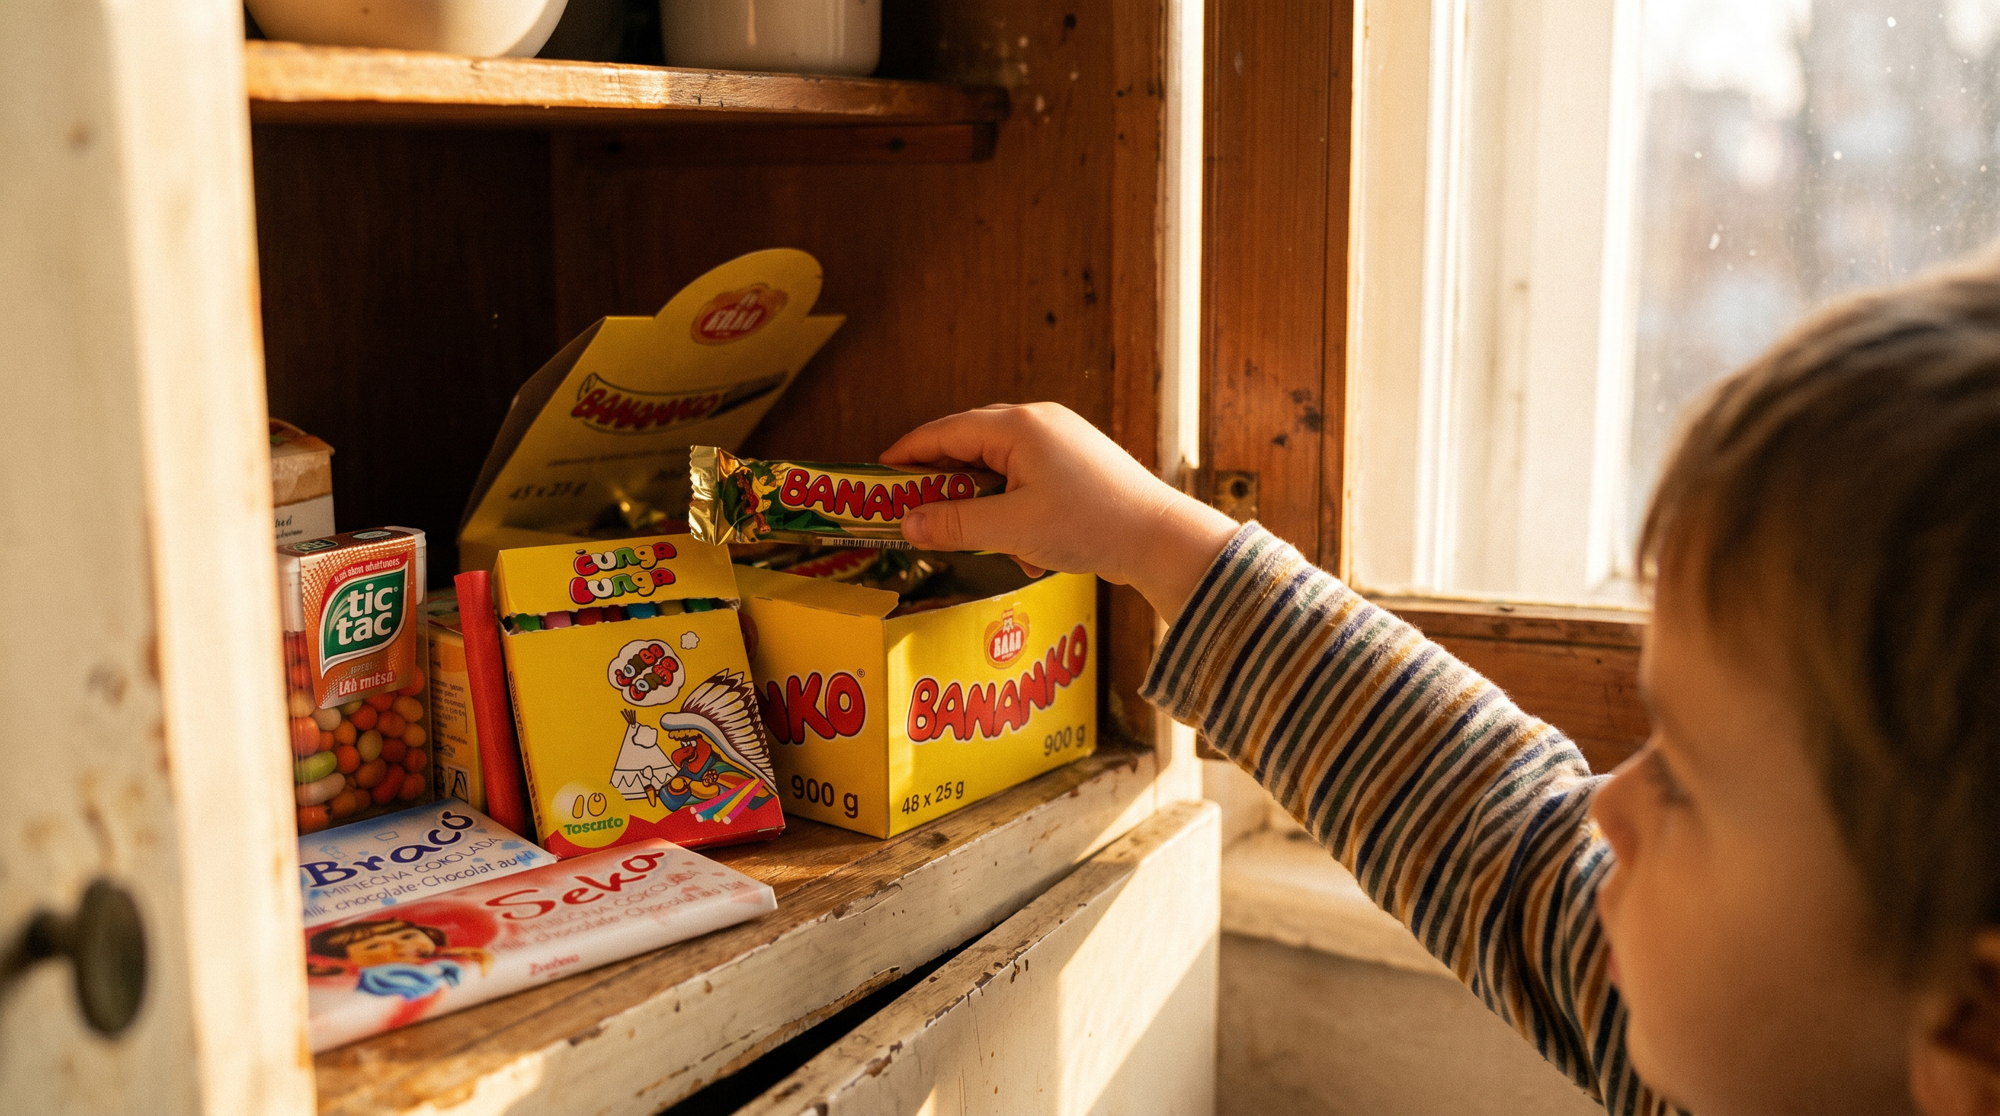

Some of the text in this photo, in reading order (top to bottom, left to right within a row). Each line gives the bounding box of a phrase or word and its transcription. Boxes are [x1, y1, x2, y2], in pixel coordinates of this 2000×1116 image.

[780, 469, 975, 521] BANANKO
[347, 583, 393, 618] tic
[336, 612, 393, 646] tac
[908, 624, 1088, 742] BANANKO
[1044, 724, 1086, 757] 900 g
[791, 774, 859, 819] 900 g
[902, 780, 965, 815] 48 x 25 g
